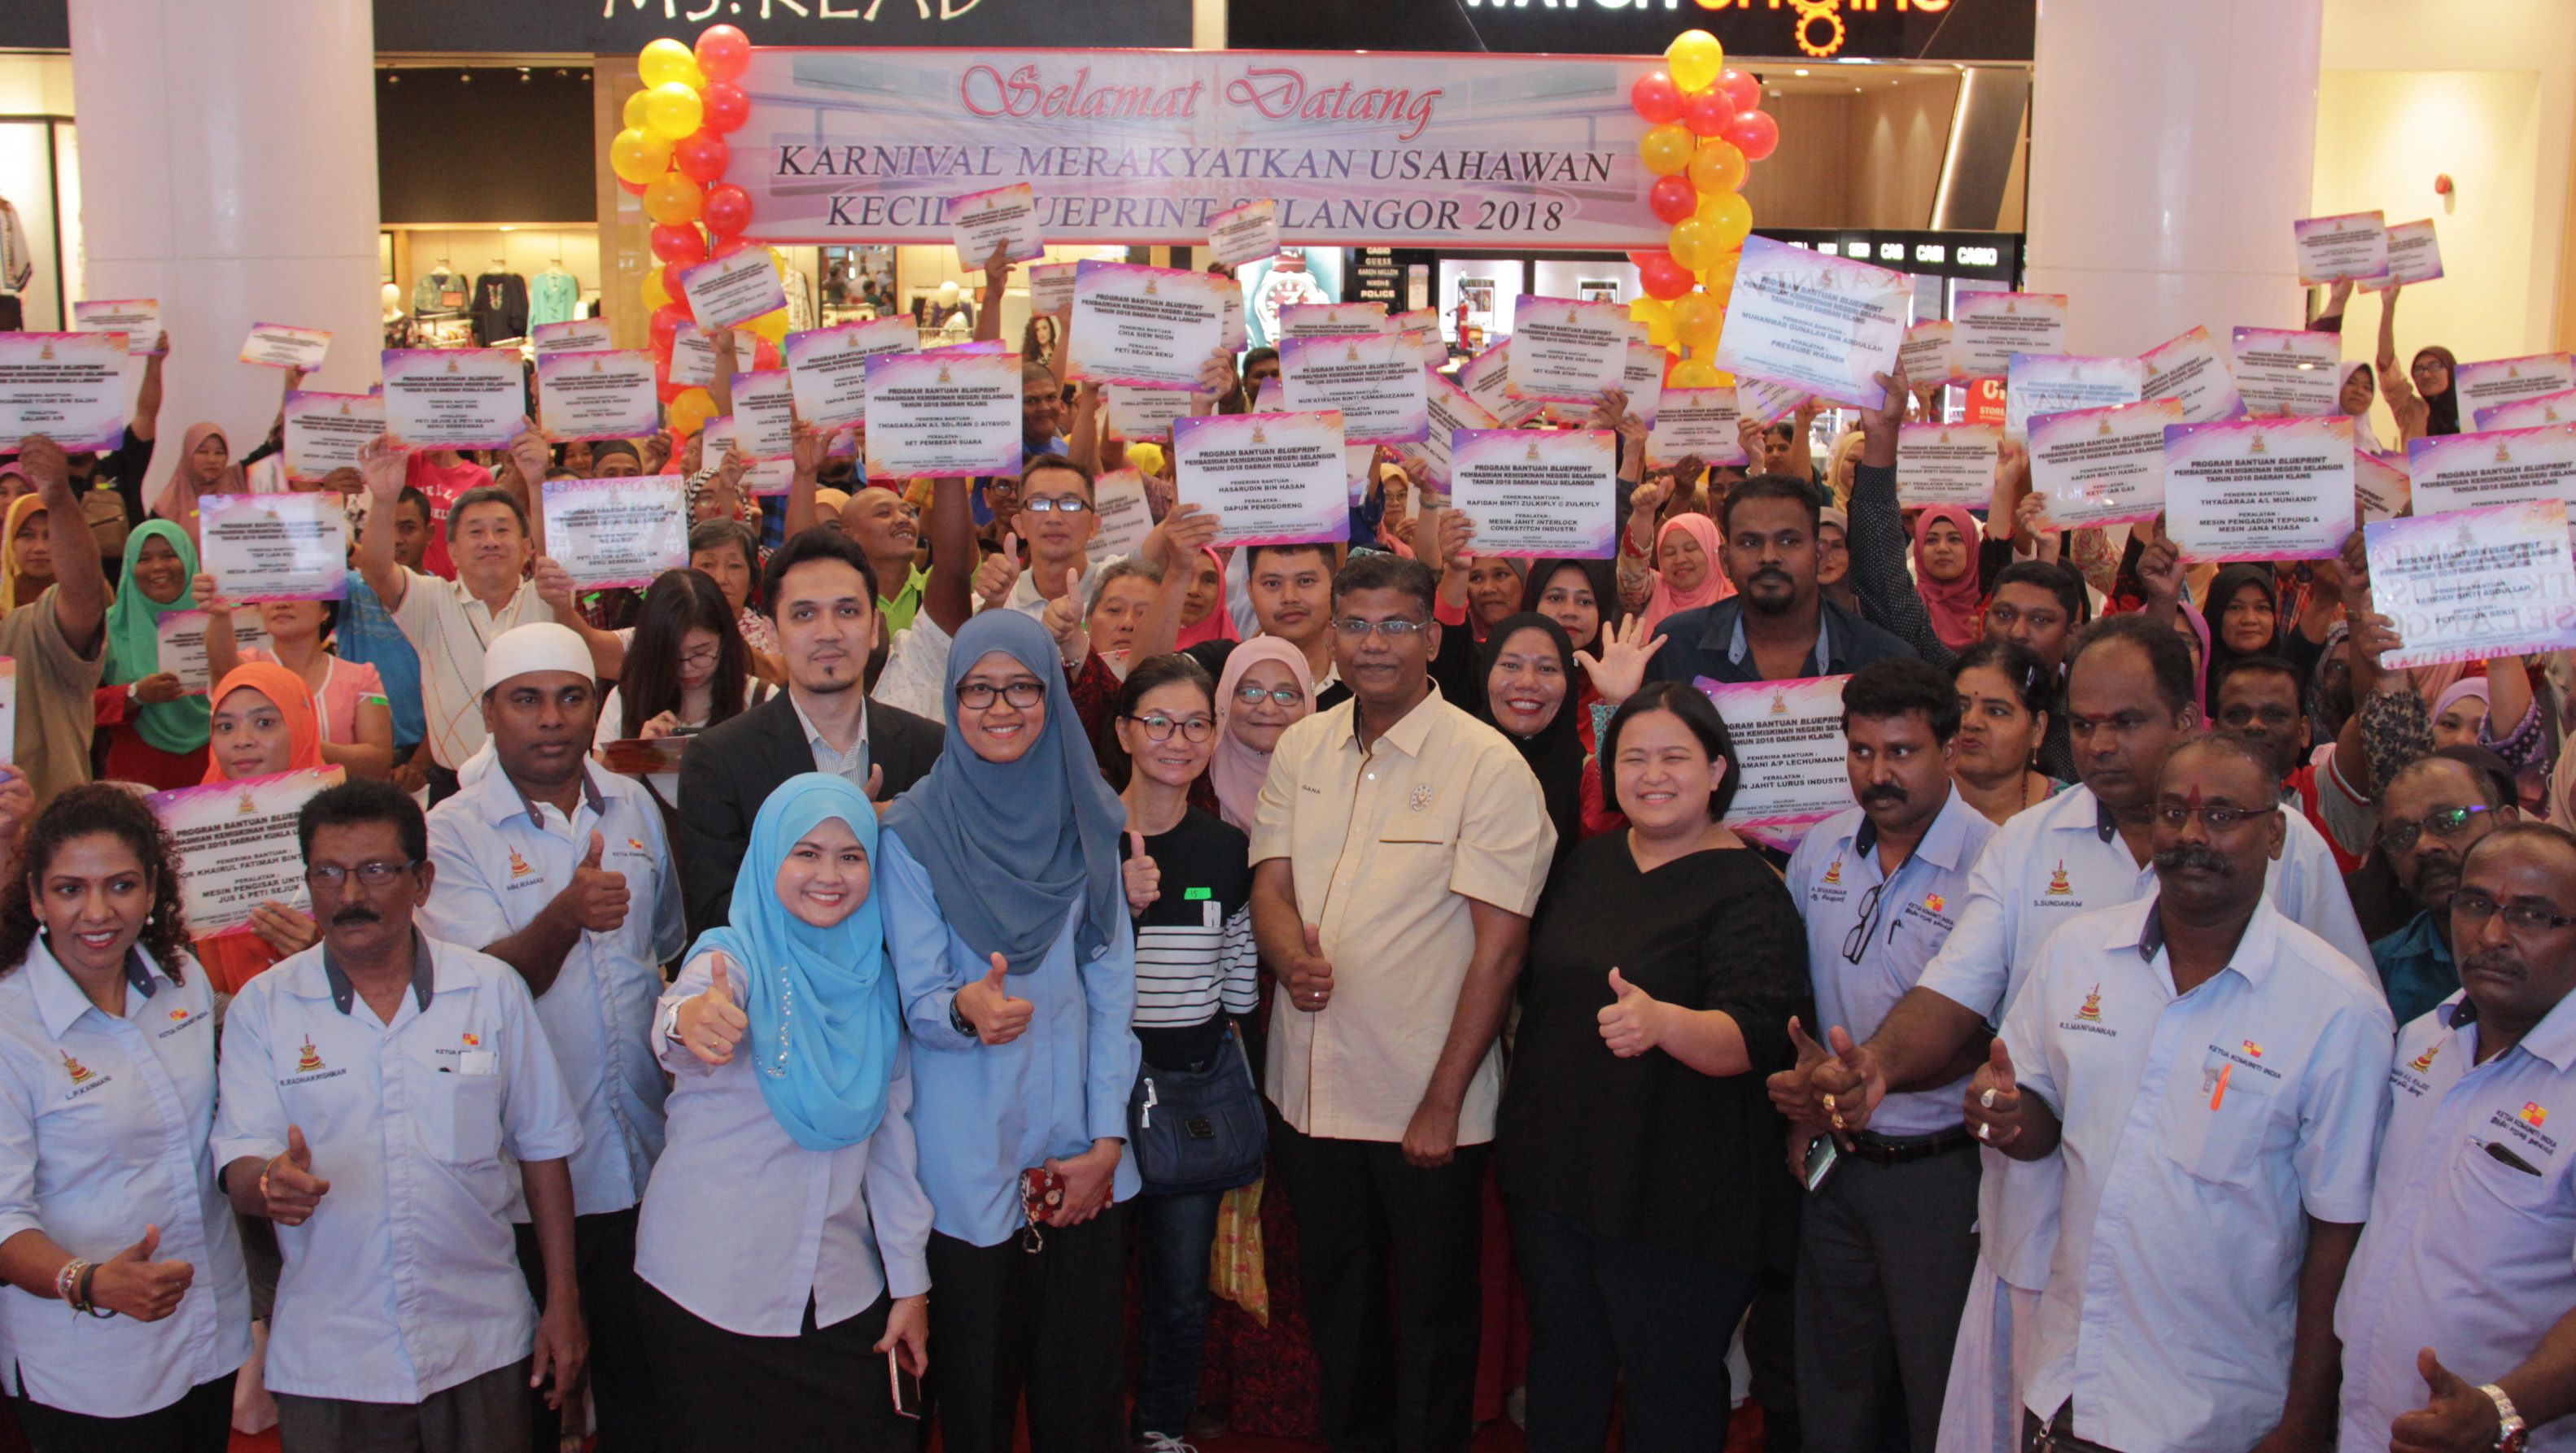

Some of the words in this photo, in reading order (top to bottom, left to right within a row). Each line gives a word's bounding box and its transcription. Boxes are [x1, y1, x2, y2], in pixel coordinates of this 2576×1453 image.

[961, 63, 1204, 120] Selamat
[1227, 65, 1443, 142] Datang
[776, 145, 1002, 177] KARNIVAL
[1015, 146, 1356, 179] MERAKYATKAN
[1370, 149, 1615, 182] USAHAWAN
[826, 195, 950, 227] KECIL
[1033, 196, 1218, 228] UEPRINT
[1474, 200, 1564, 232] 2018
[1365, 257, 1392, 265] GUESS
[1360, 290, 1396, 299] POLICE
[2234, 458, 2275, 466] BANTUAN
[2278, 456, 2325, 465] BLUEPRINT
[1757, 720, 1797, 728] BANTUAN
[1747, 727, 1793, 736] KEMISKINAN
[1776, 735, 1806, 743] DAERAH
[1786, 757, 1845, 766] LECHUMANAN
[2033, 900, 2083, 908] S.SUNDARAM
[2208, 1045, 2229, 1056] KETUA
[2230, 1055, 2263, 1069] KOMUNITI
[2263, 1067, 2281, 1077] INDIA
